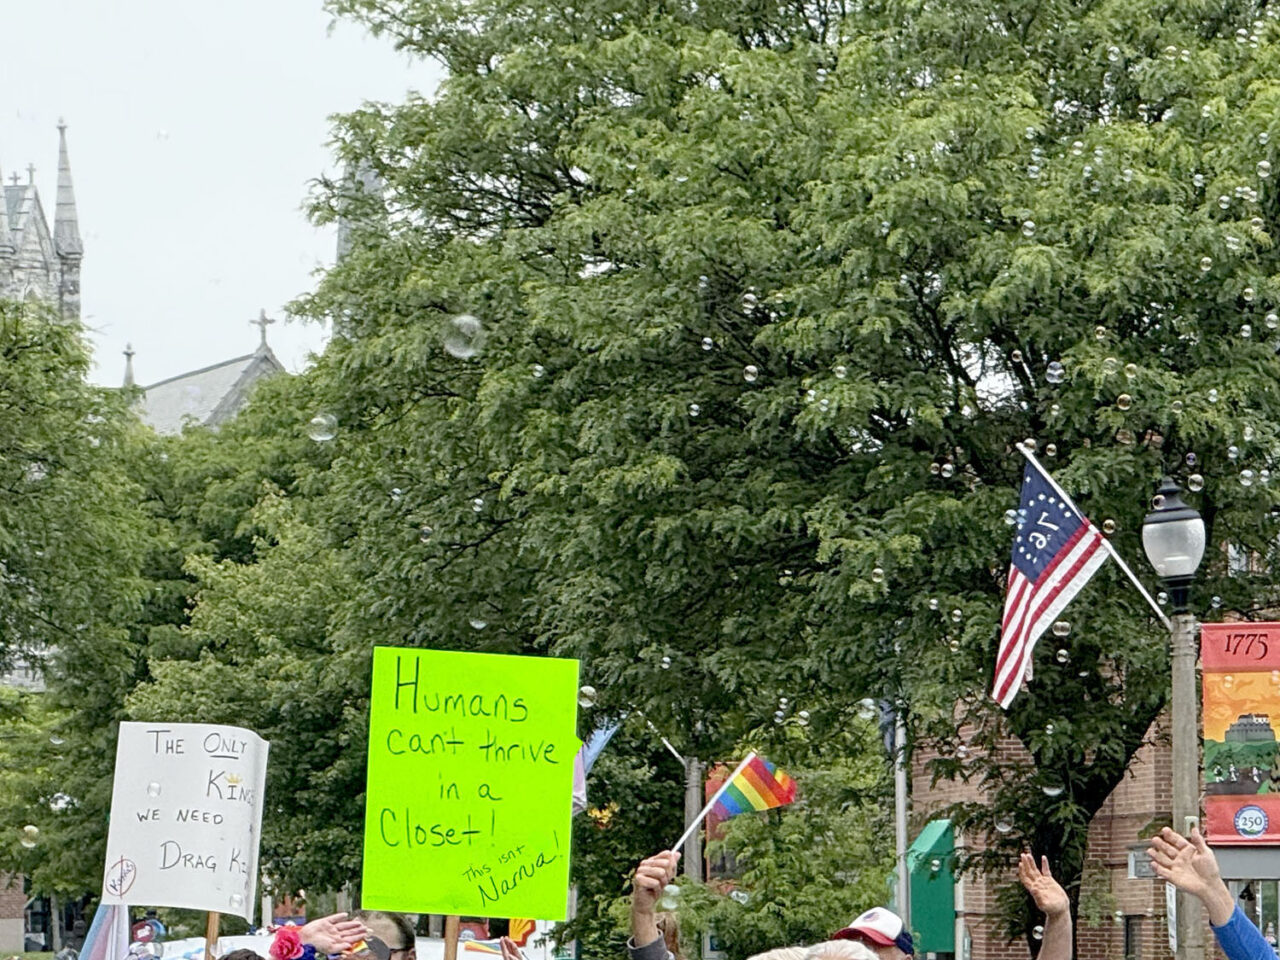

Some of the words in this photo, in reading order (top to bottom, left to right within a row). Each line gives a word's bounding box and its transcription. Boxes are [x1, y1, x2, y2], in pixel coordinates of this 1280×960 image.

[1225, 633, 1268, 661] 1775
[395, 656, 528, 722] Humans
[146, 729, 185, 755] THE
[203, 732, 248, 754] ONLY
[479, 729, 558, 764] thrive
[438, 771, 460, 800] in
[478, 783, 503, 801] a
[137, 808, 160, 822] WE
[176, 809, 224, 825] NEED
[1241, 816, 1263, 829] 250
[160, 840, 217, 872] DRAG
[462, 864, 492, 882] This
